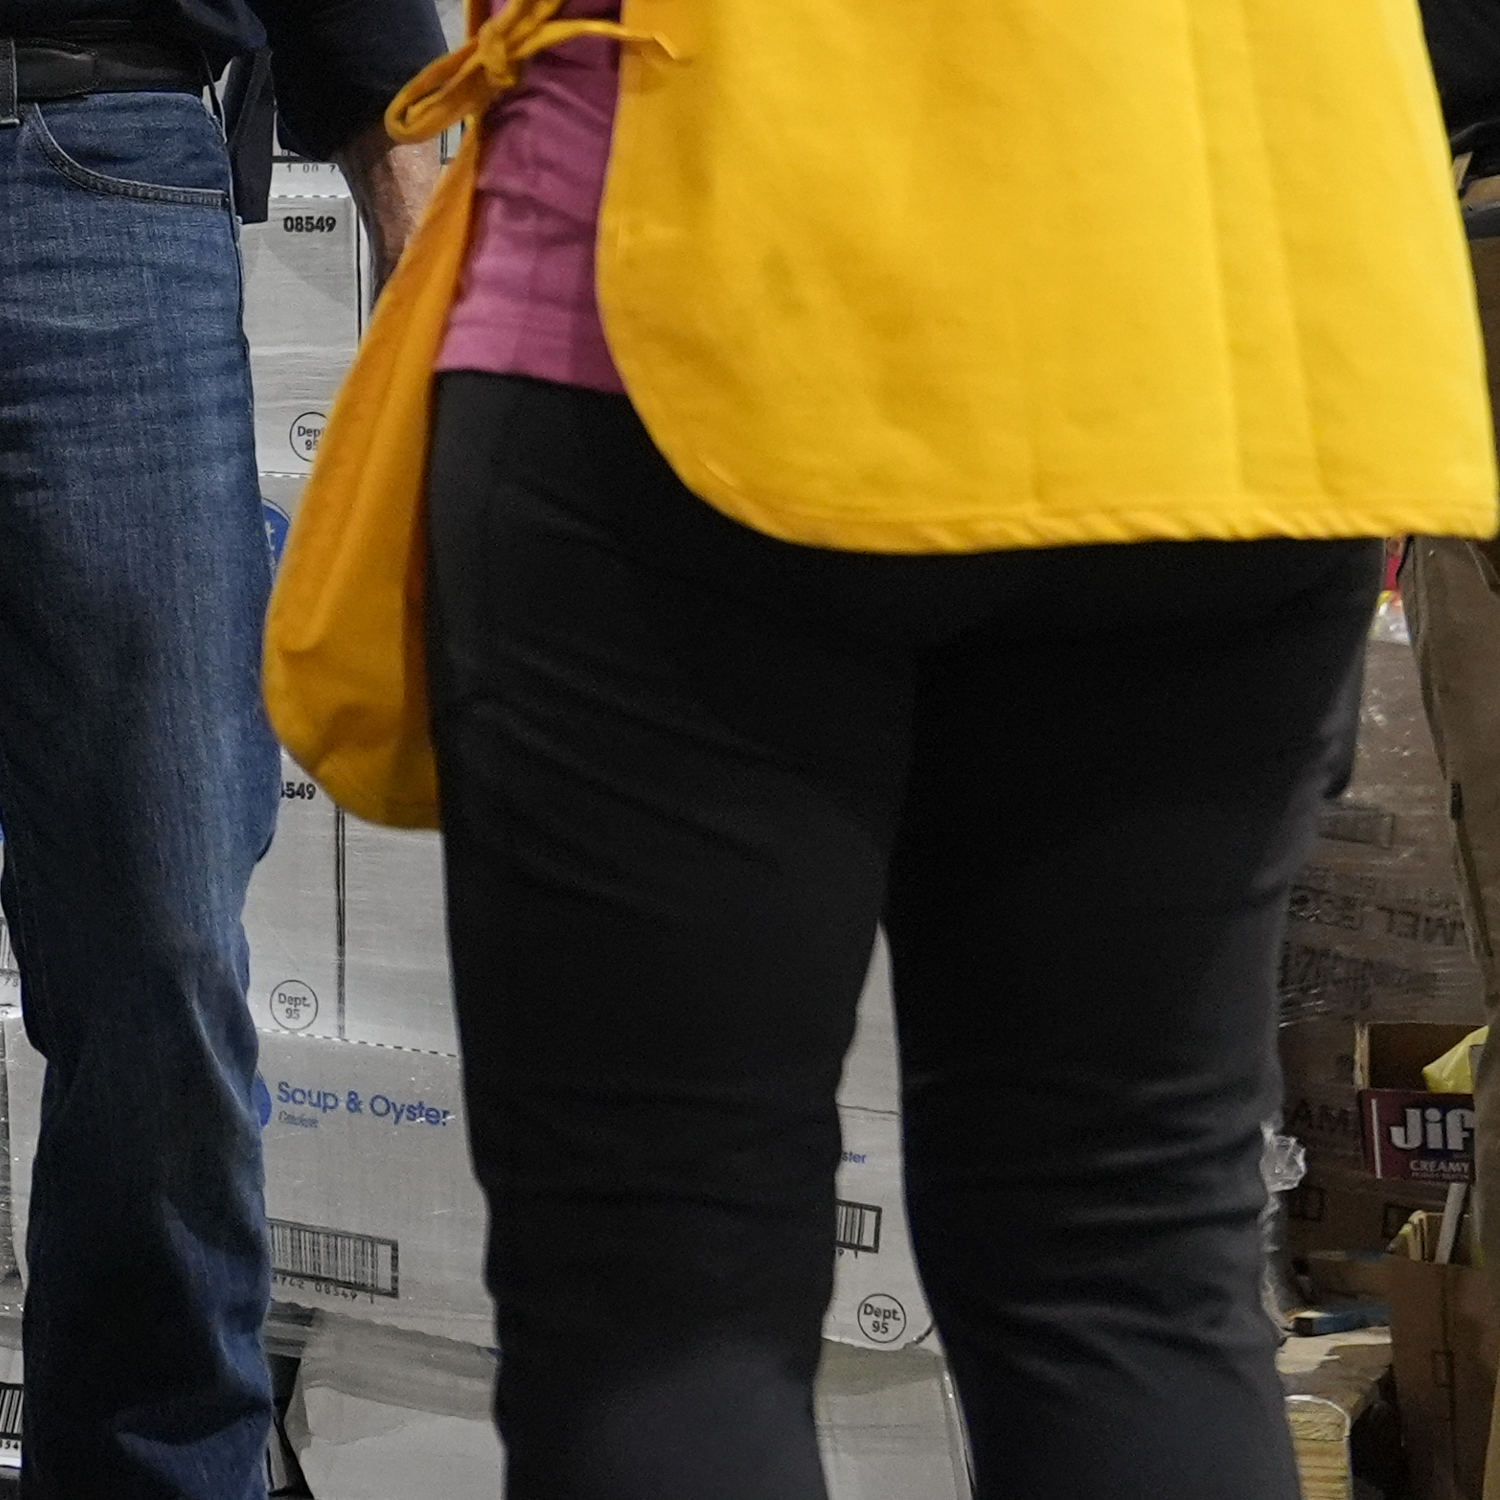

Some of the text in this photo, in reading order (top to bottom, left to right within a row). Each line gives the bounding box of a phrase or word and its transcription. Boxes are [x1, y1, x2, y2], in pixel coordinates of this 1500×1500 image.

[283, 215, 337, 233] 08549
[279, 781, 317, 800] 549
[278, 992, 312, 1009] Dept.
[285, 1007, 301, 1020] 95
[276, 1080, 451, 1126] Soup & Oyster
[1389, 1106, 1475, 1151] Jif
[841, 1151, 867, 1164] ster
[1409, 1159, 1471, 1174] CREAMY
[862, 1303, 901, 1322] Dept.
[871, 1319, 889, 1334] 95
